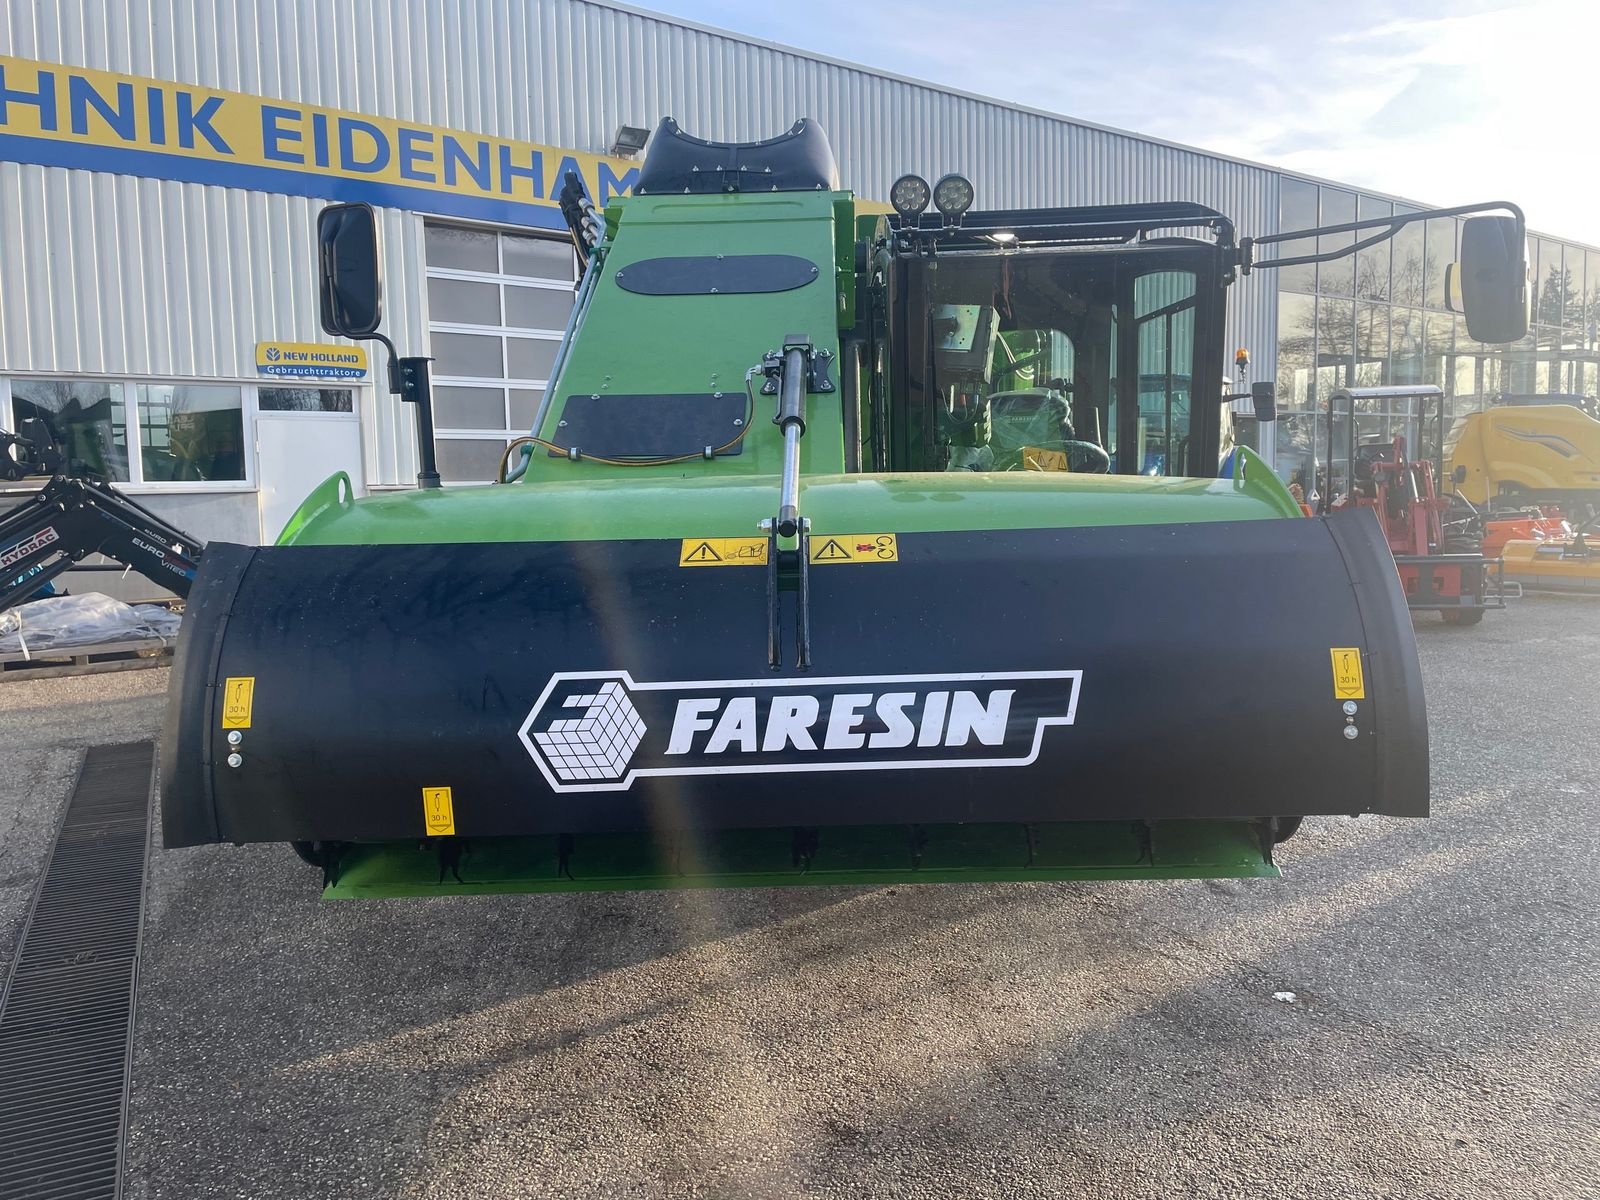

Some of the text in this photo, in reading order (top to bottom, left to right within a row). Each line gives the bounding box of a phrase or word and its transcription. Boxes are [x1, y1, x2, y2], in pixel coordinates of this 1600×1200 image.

[283, 351, 359, 363] NEW HOLLAND
[267, 366, 361, 377] Gebrauchttraktore
[1, 533, 56, 565] HYDRAC
[132, 537, 165, 558] EURO
[1340, 676, 1357, 684] 30 h
[228, 705, 246, 713] 30 h
[663, 689, 1017, 756] FARESIN
[431, 814, 441, 822] 30
